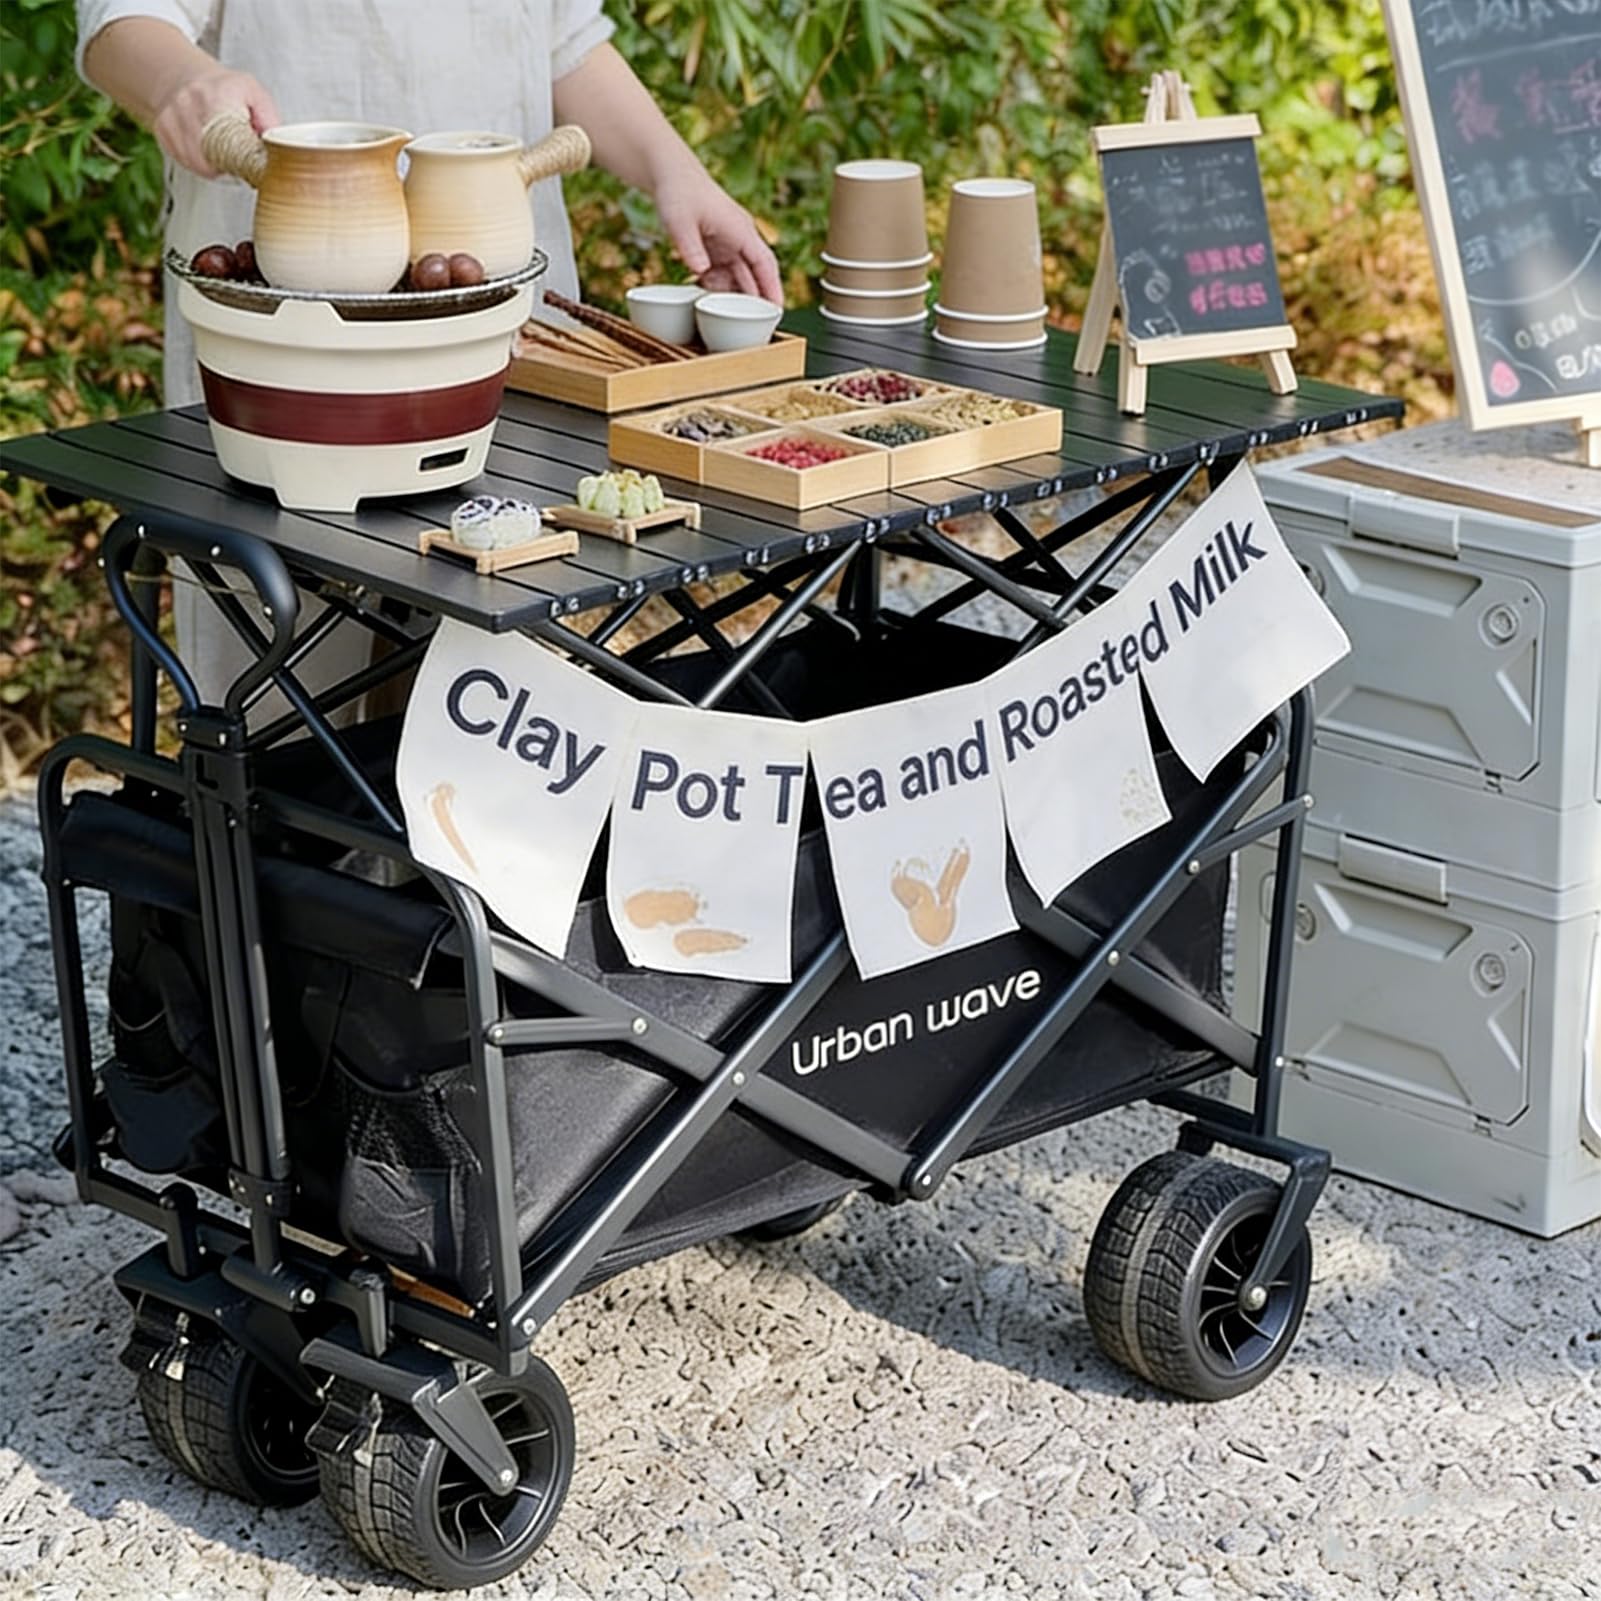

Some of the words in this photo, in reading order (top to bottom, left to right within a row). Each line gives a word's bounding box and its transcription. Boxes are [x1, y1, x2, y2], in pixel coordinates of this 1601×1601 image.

[446, 668, 606, 795] Clay
[631, 749, 746, 822] Pot
[765, 764, 887, 824] Tea
[900, 719, 990, 800] and
[999, 599, 1170, 763] Roasted
[1168, 521, 1268, 633] Milk
[792, 1012, 913, 1075] Urban
[926, 969, 1041, 1032] wave
